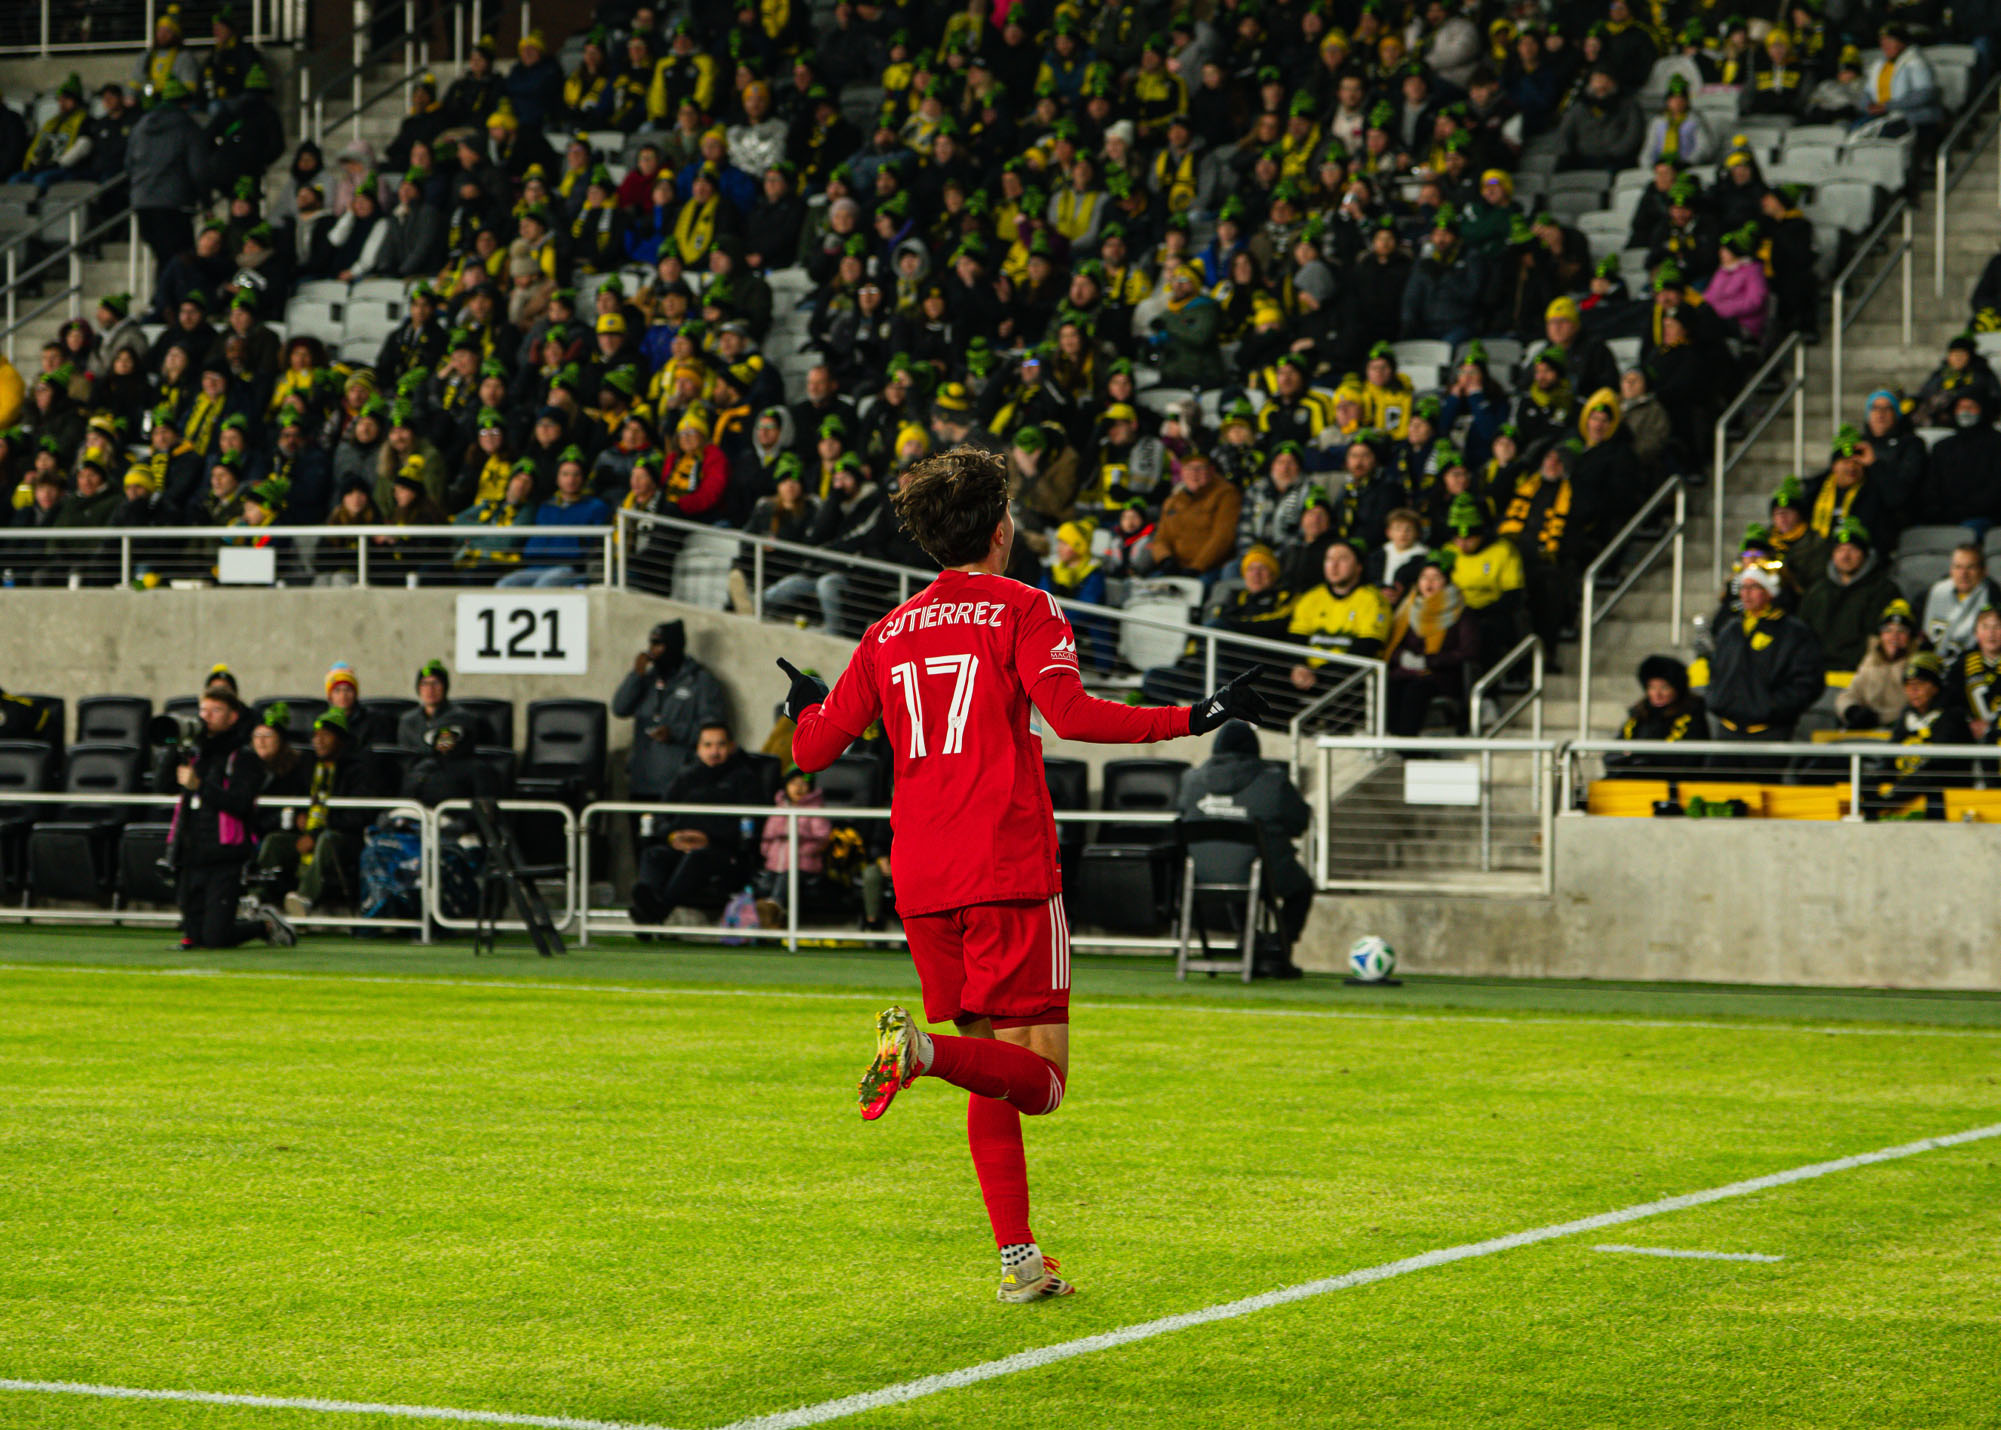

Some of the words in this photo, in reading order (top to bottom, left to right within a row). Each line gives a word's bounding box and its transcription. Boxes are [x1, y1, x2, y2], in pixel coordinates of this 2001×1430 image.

[477, 608, 566, 658] 121
[878, 598, 1006, 643] GUTIÉRREZ
[891, 654, 979, 758] 17
